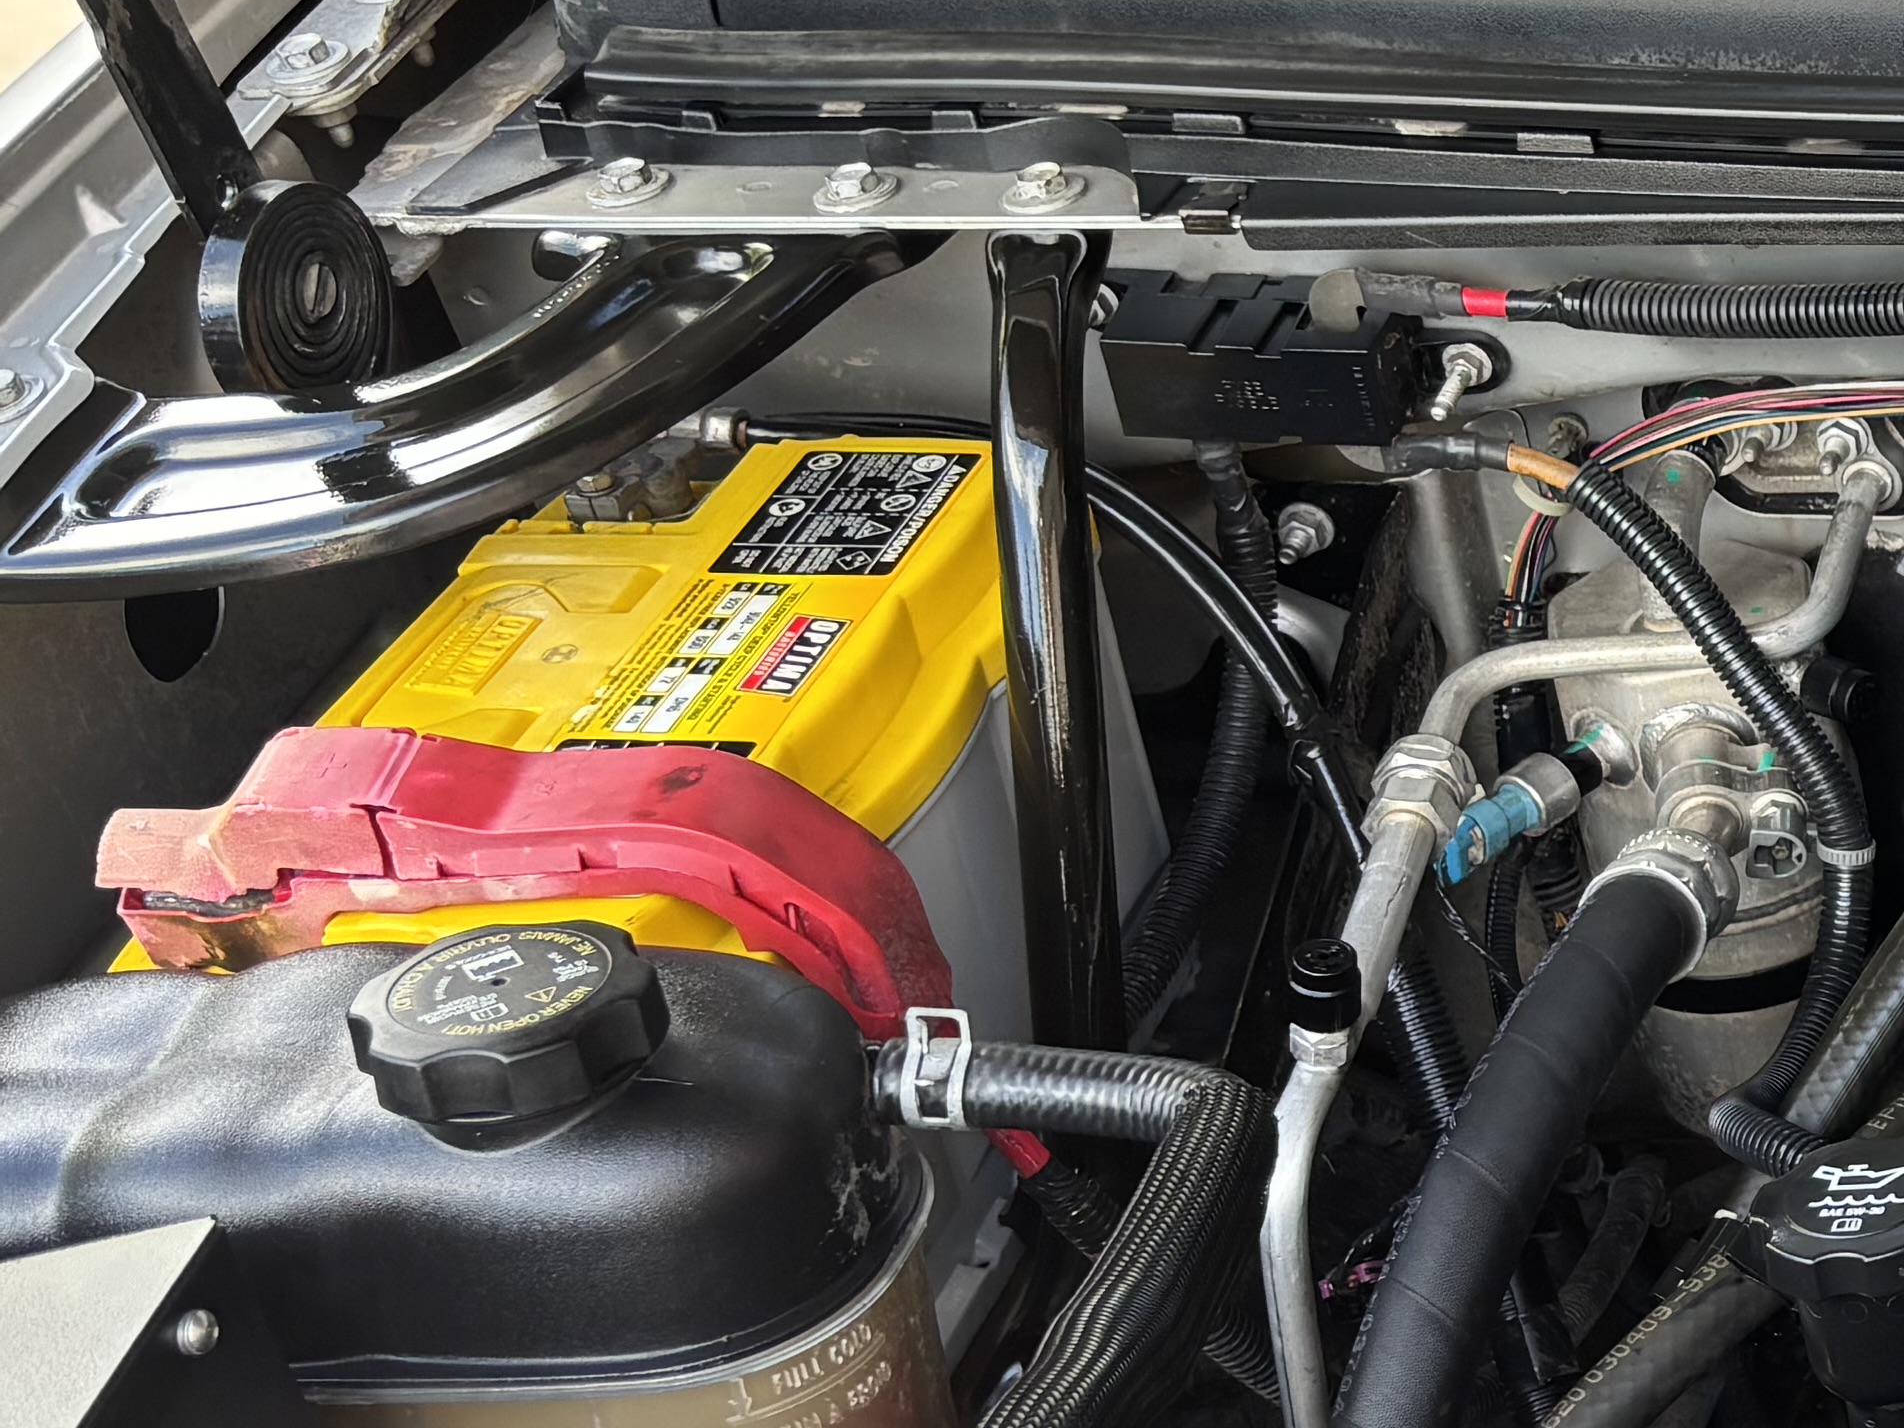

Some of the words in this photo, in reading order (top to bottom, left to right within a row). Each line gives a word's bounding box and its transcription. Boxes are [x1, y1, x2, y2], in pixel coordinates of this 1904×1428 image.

[874, 473, 965, 563] DANGER/POISON
[756, 619, 846, 692] OPTIMA
[537, 985, 594, 1018] NEVER
[490, 1008, 540, 1033] OPEN
[1818, 1207, 1845, 1218] SAE
[1846, 1205, 1886, 1217] 5W-30
